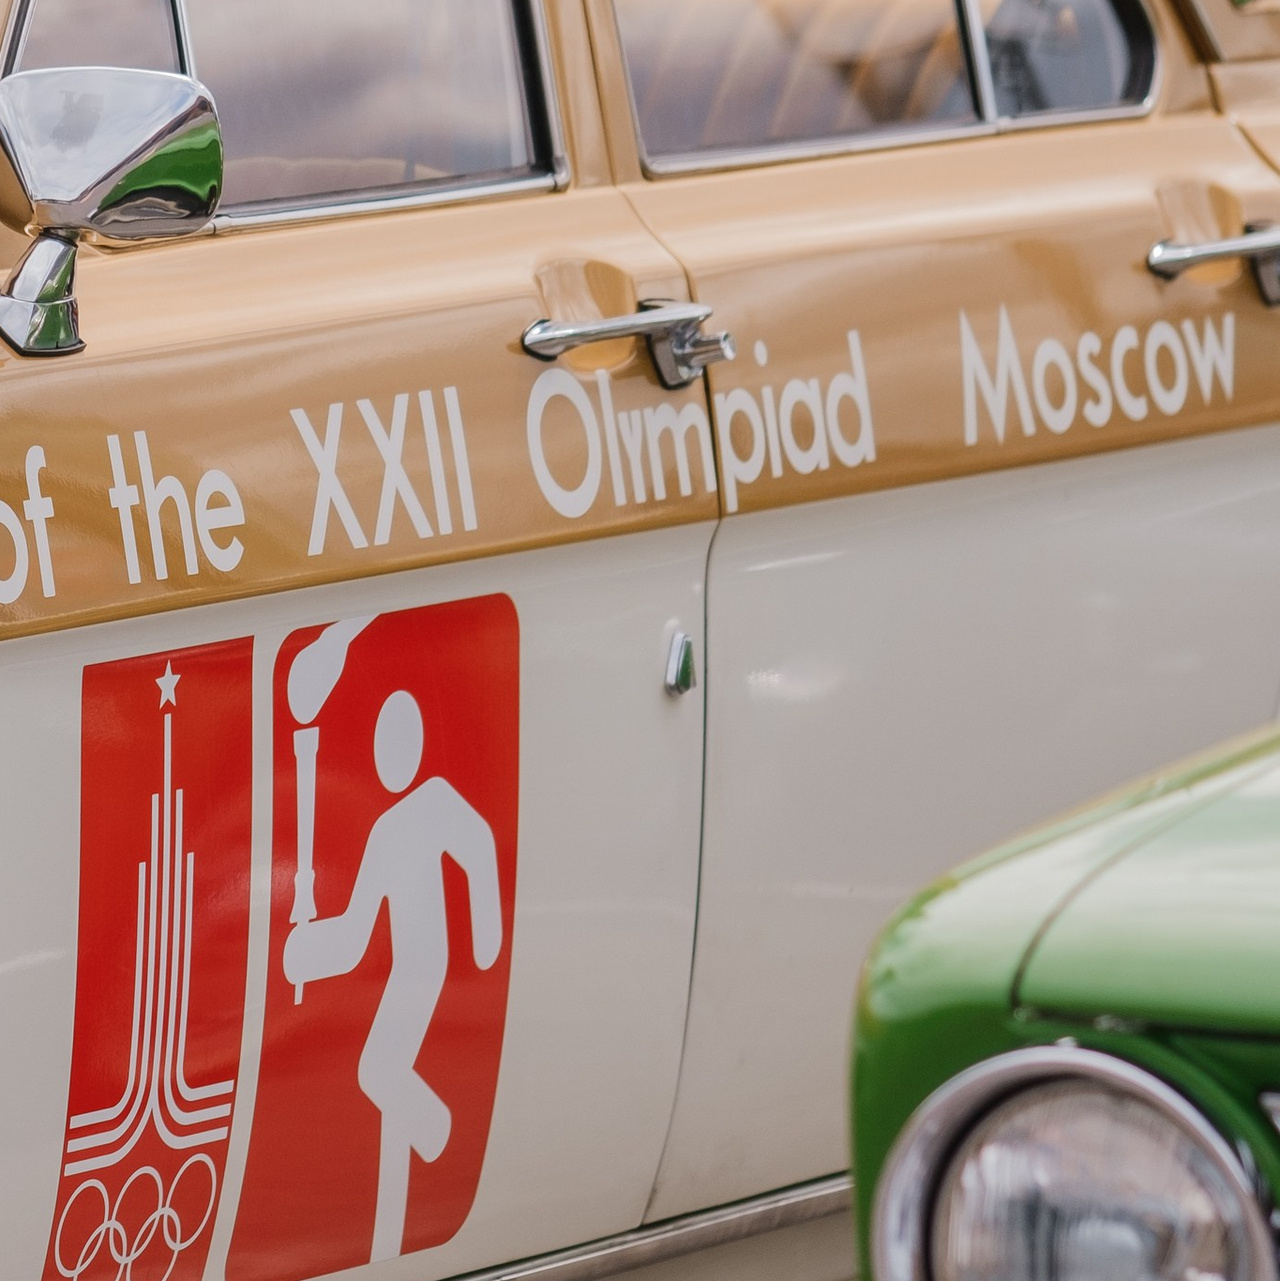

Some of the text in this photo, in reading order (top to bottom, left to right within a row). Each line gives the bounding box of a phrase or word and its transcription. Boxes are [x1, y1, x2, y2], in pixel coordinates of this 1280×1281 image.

[107, 431, 245, 584] the
[290, 386, 477, 555] XXII
[526, 330, 875, 517] Olympiad
[959, 306, 1234, 444] Moscow
